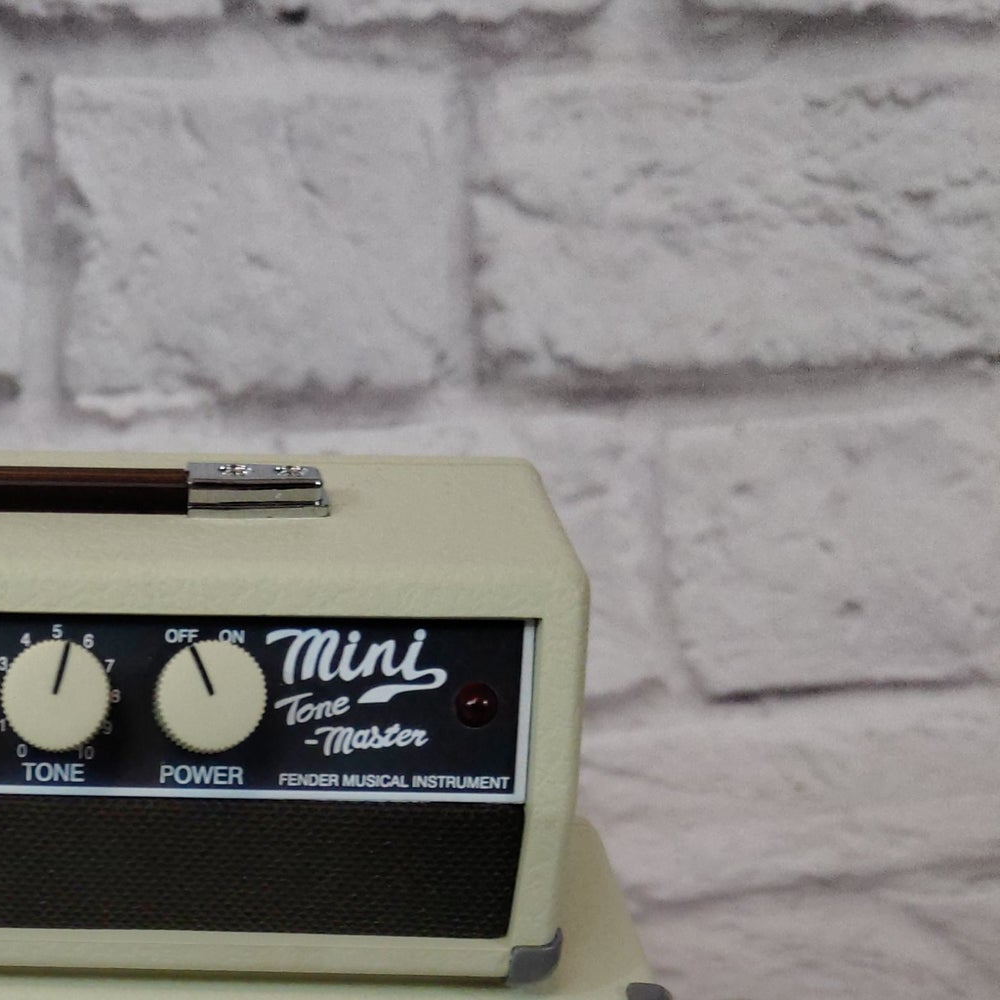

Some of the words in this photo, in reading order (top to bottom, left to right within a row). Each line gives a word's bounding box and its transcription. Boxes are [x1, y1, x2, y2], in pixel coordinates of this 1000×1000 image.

[52, 624, 63, 639] 5
[165, 629, 199, 644] OFF
[219, 629, 245, 644] ON
[20, 633, 31, 646] 4
[83, 634, 94, 649] 6
[104, 659, 116, 673] 7
[265, 628, 448, 704] Mini
[274, 692, 350, 726] Tone
[0, 718, 6, 732] 1
[16, 744, 28, 758] 0
[78, 746, 95, 760] 10
[21, 762, 85, 782] TONE
[159, 765, 244, 785] POWER
[278, 773, 339, 787] FENDER
[342, 774, 409, 788] MUSICAL
[412, 775, 511, 790] INSTRUMENT
